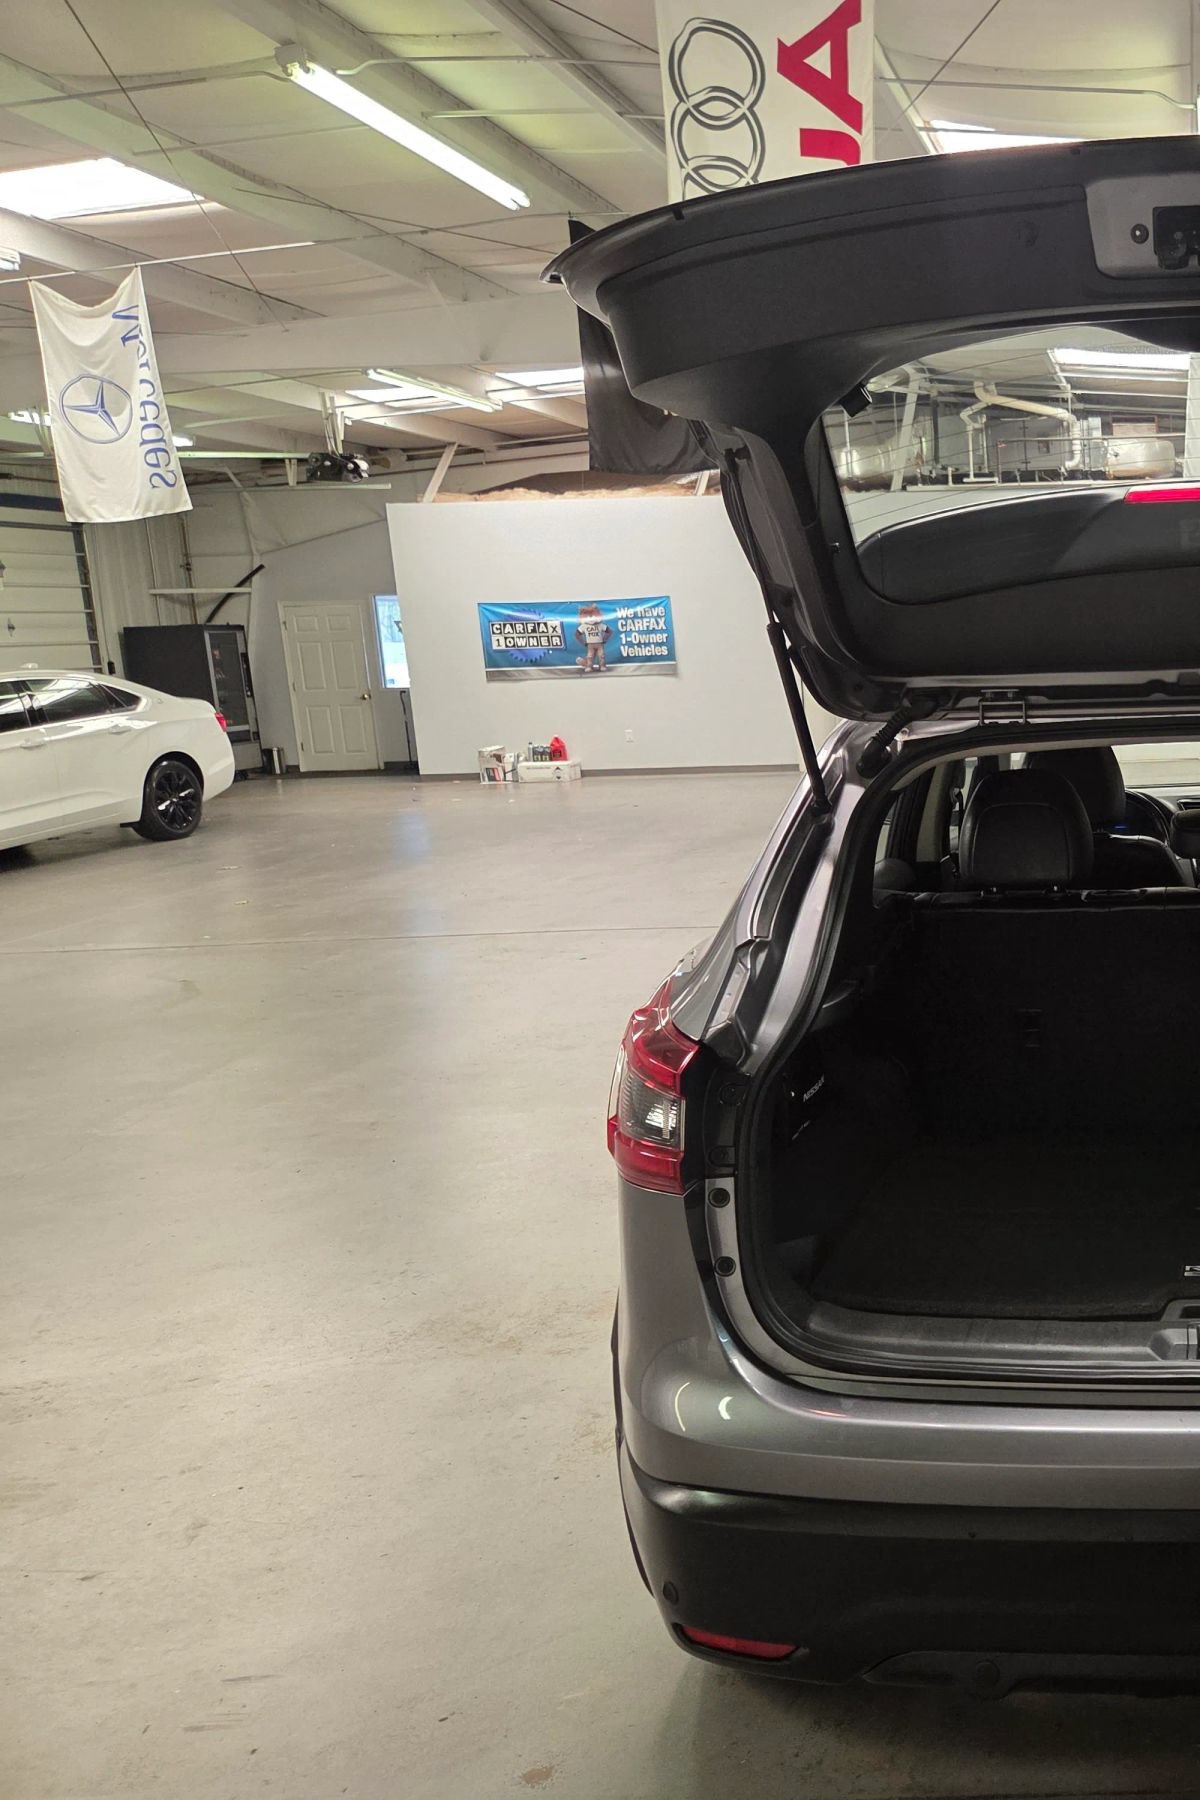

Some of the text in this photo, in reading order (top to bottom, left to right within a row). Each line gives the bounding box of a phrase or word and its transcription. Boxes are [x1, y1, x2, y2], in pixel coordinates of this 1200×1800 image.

[617, 607, 634, 618] We
[492, 622, 559, 634] CARFAX
[618, 618, 667, 631] CARFAX
[620, 632, 668, 645] 1-Owner
[620, 644, 669, 657] Vehicles
